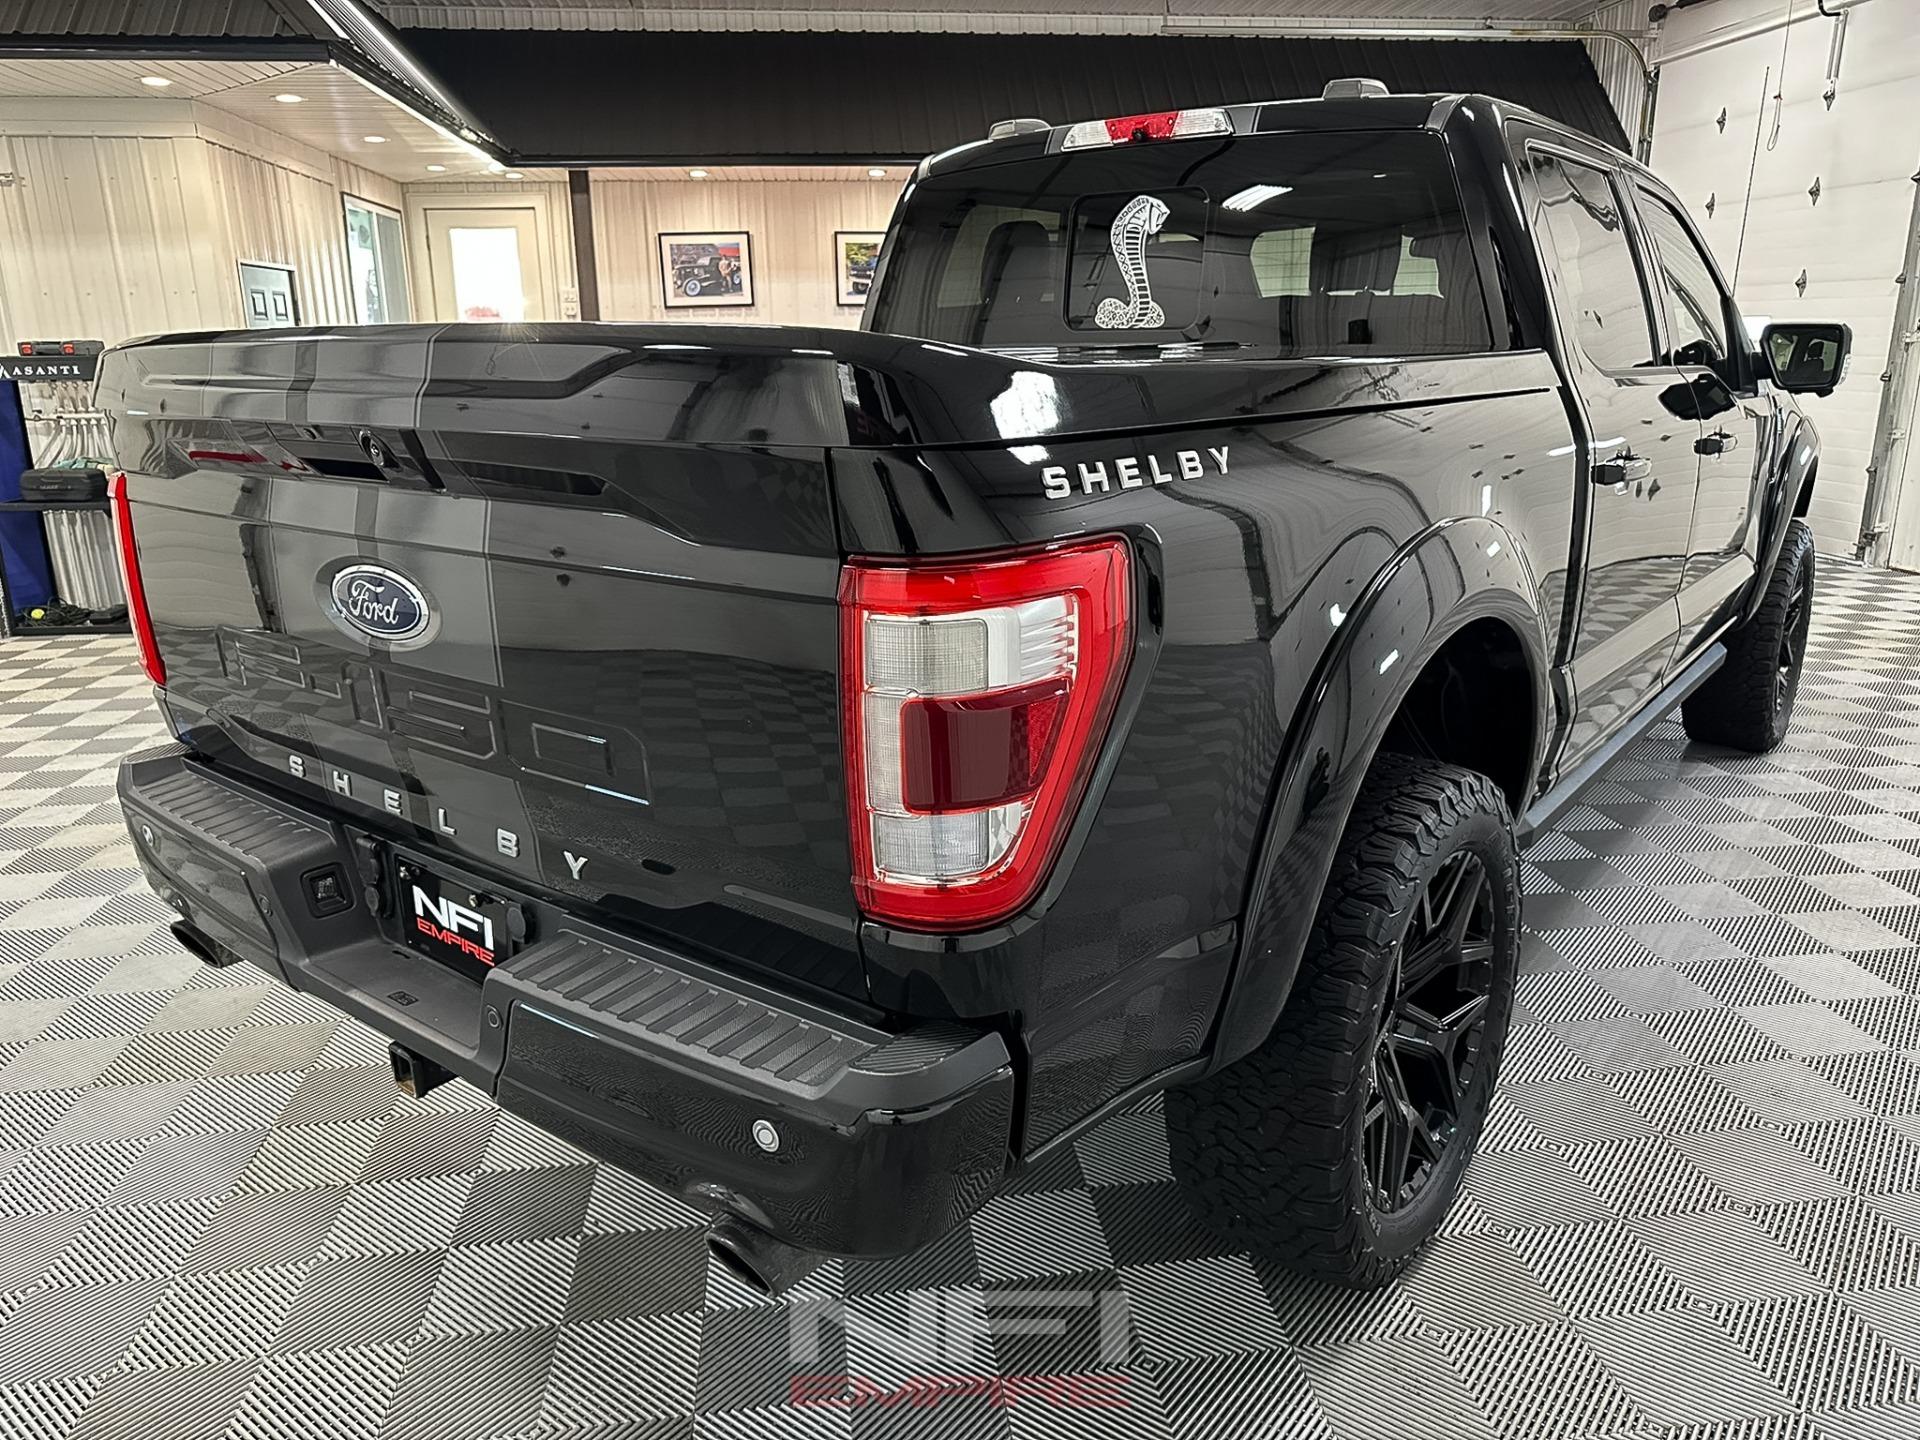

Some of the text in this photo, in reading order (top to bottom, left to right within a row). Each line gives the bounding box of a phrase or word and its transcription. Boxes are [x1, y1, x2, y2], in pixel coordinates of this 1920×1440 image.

[12, 365, 81, 376] ASANTI
[1041, 446, 1229, 500] SHELBY
[348, 579, 400, 625] Ford
[288, 754, 588, 880] SHELBY
[412, 884, 495, 952] NFI
[416, 916, 496, 968] EMPIRE
